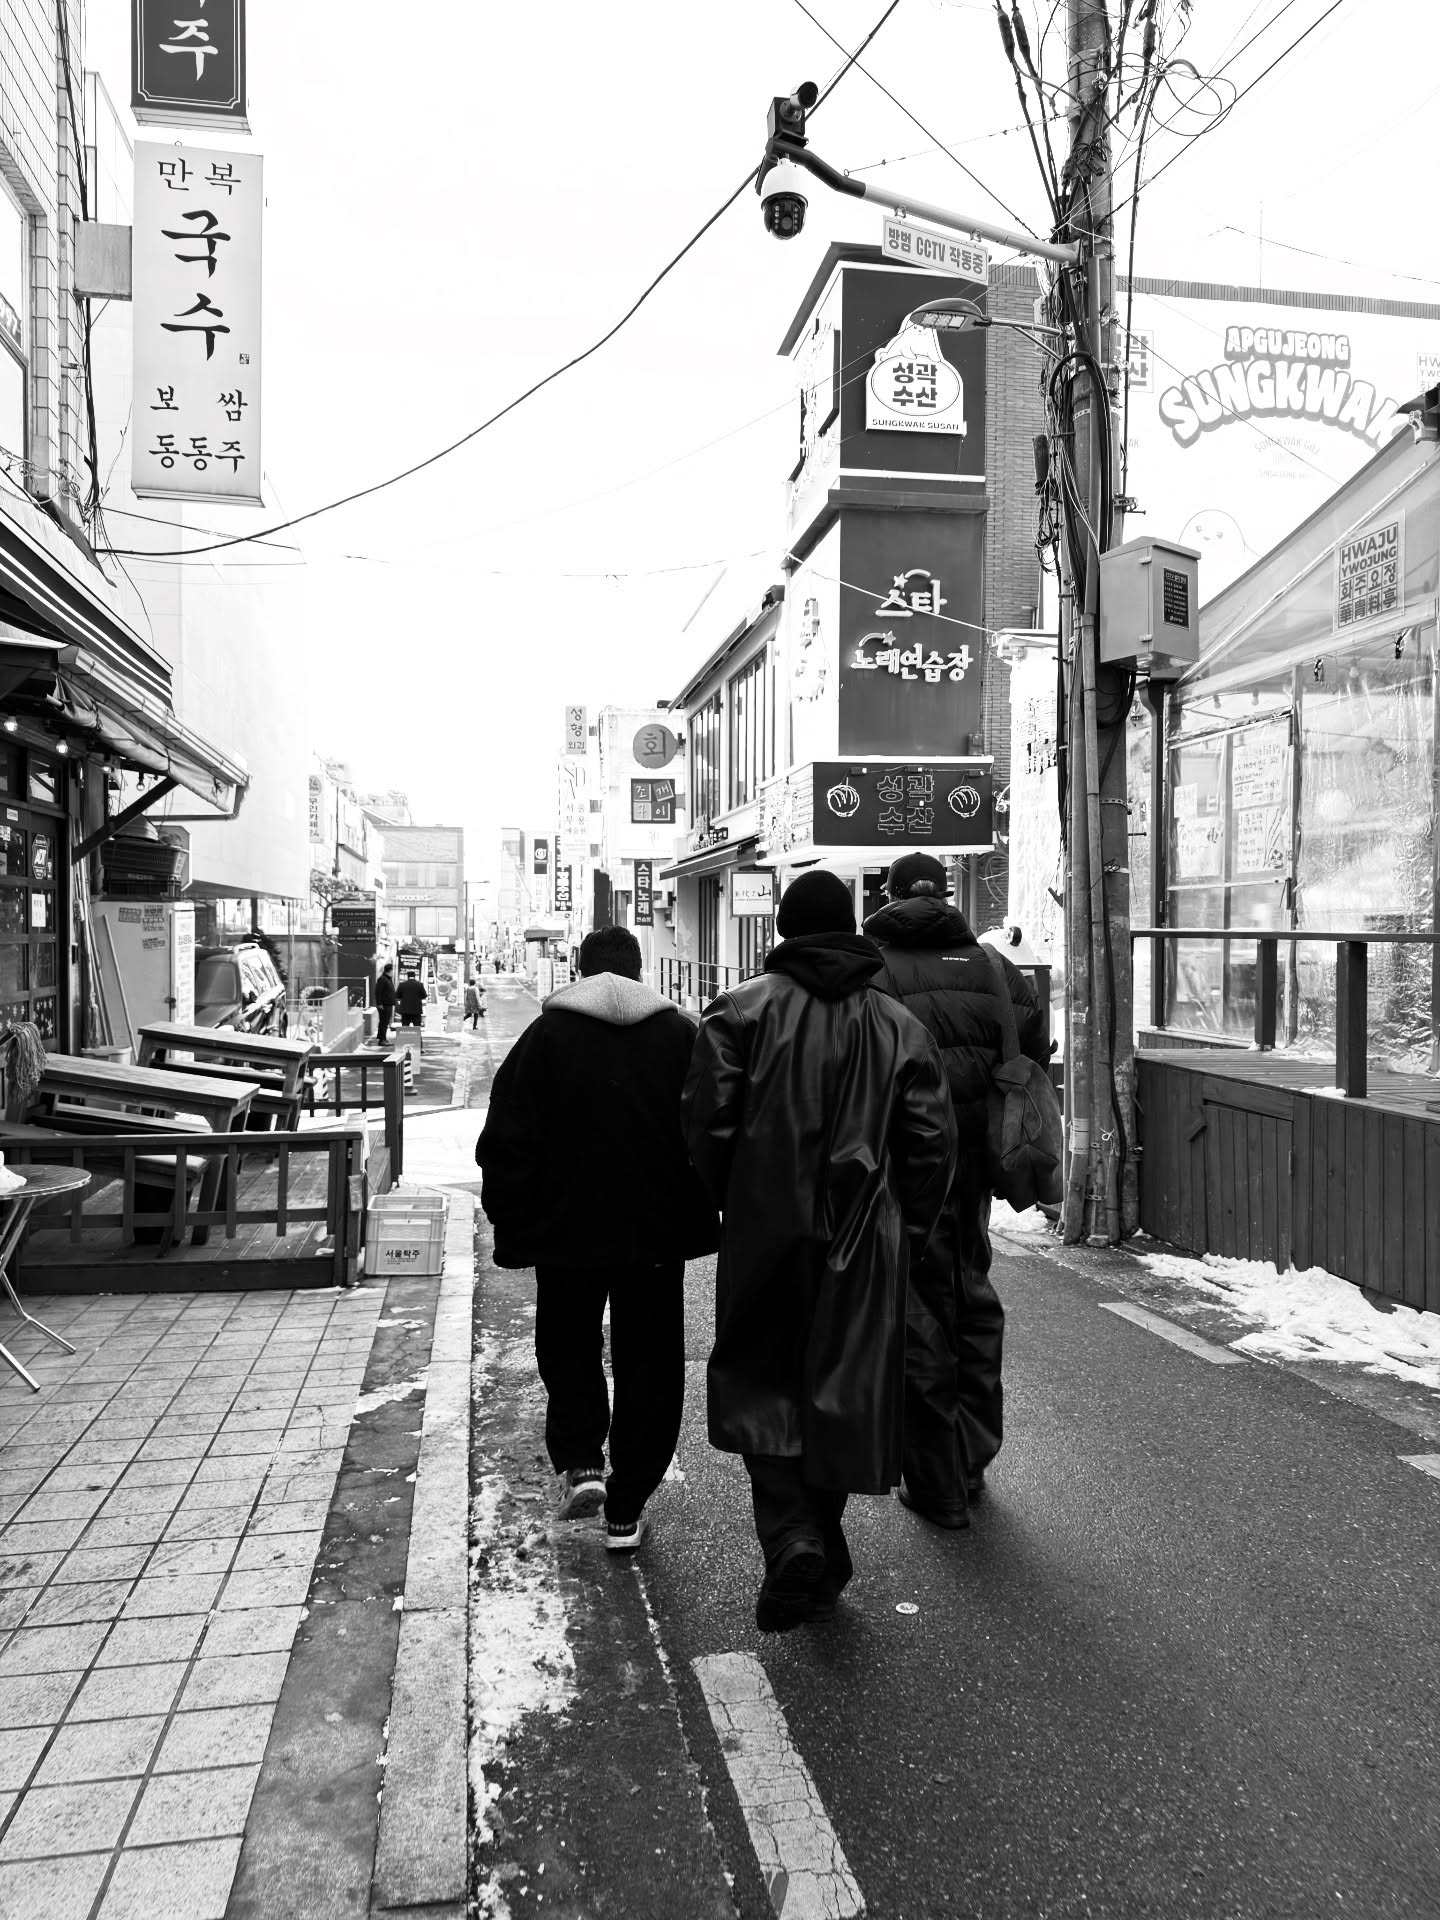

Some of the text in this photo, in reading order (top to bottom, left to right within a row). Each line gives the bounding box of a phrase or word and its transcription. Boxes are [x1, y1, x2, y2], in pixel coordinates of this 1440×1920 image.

[158, 0, 219, 81] 주
[157, 157, 242, 196] 만복
[888, 227, 983, 275] 방범 CCTV 작동중
[160, 209, 231, 361] 국수
[1224, 326, 1350, 368] APGUJEONG
[892, 362, 937, 385] 성곽
[150, 385, 248, 422] 보쌈
[892, 386, 937, 408] 수산
[1159, 359, 1411, 453] SUNGKWAK
[872, 418, 959, 430] SUNGKWAK SUSAN
[149, 434, 246, 473] 동동주
[1341, 526, 1397, 565] HWAJU
[1341, 545, 1397, 578] YWOJUNG
[875, 578, 948, 617] 스타
[1340, 562, 1396, 602] 화주요정
[850, 643, 974, 682] 노래연습장
[876, 775, 935, 803] 성곽
[877, 807, 935, 835] 수산
[637, 863, 650, 915] 스타노래
[385, 1249, 420, 1258] 서울탁주
